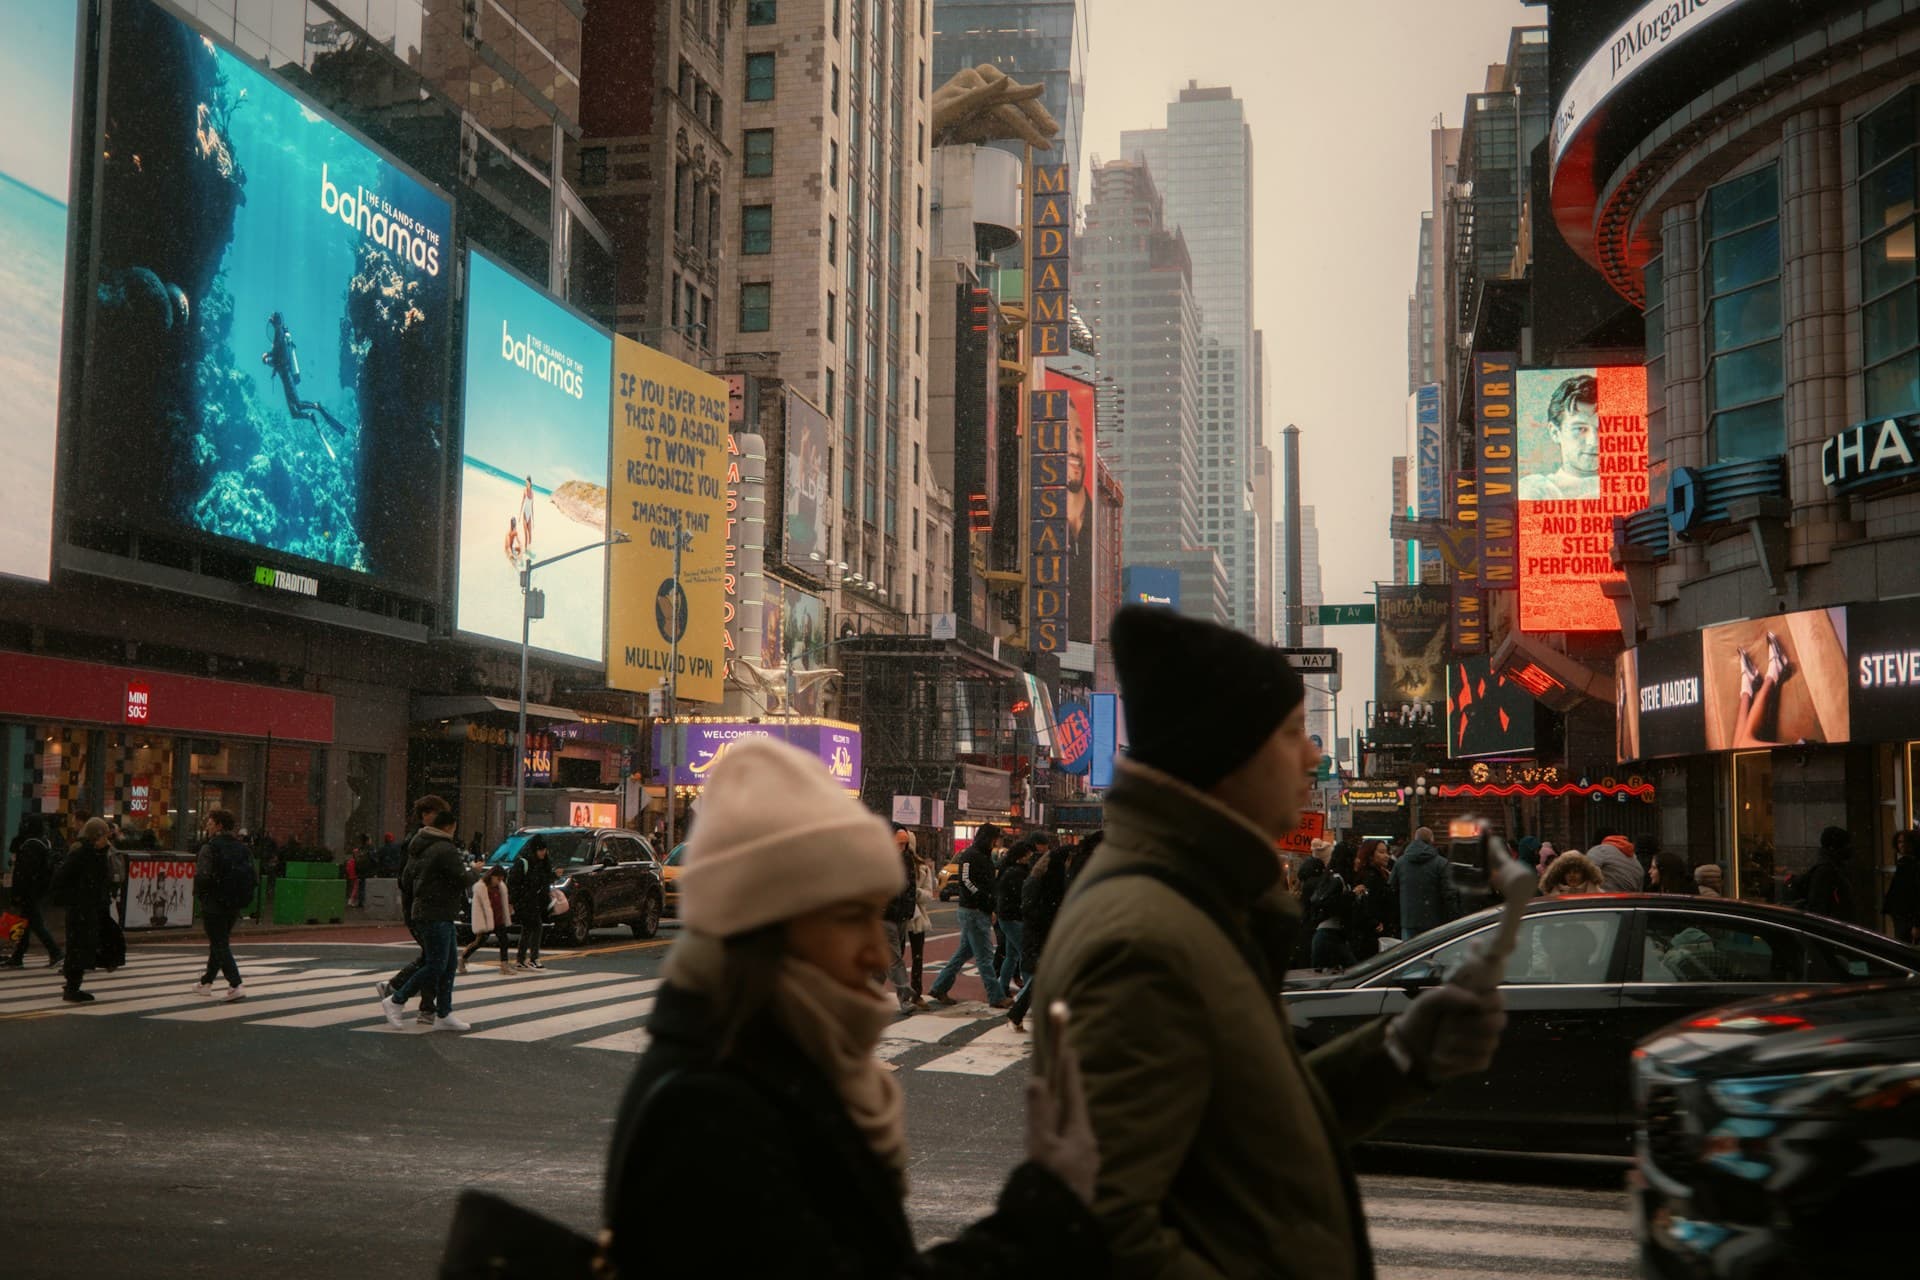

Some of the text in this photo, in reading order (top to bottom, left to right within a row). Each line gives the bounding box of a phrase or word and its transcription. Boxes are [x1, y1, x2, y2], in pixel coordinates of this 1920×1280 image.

[1610, 0, 1708, 80] JPMorgan
[321, 162, 439, 276] bahamas
[365, 189, 440, 246] THE ISLANDS OF THE
[1036, 165, 1066, 355] MADAME
[502, 319, 583, 399] bahamas
[620, 372, 726, 424] IF YOU EVER PASS
[625, 402, 723, 452] THIS AD AGAIN,
[1482, 361, 1511, 496] VICTORY
[645, 435, 706, 471] IT WON'T
[1822, 418, 1914, 486] CHA
[627, 459, 694, 496] RECOGNIZE
[1624, 476, 1646, 492] TO
[632, 501, 710, 533] IMAGINE THAT
[1036, 392, 1062, 650] TUSSAUDS
[1533, 499, 1577, 514] BOTH
[1542, 516, 1577, 534] AND
[1486, 517, 1513, 582] NEW
[1528, 557, 1618, 575] PERFORM
[1334, 607, 1361, 625] 7 AV
[1459, 596, 1480, 645] NEW
[688, 655, 713, 679] VPN
[1302, 655, 1327, 666] WAY
[1859, 651, 1920, 687] STEVE
[128, 691, 148, 704] MINI
[1640, 677, 1698, 713] STEVE MADDEN
[703, 730, 753, 739] WELCOME
[132, 786, 148, 797] MINI
[1579, 777, 1588, 787] A
[1592, 791, 1601, 801] C
[1618, 792, 1625, 801] E
[129, 861, 197, 879] CHICAGO
